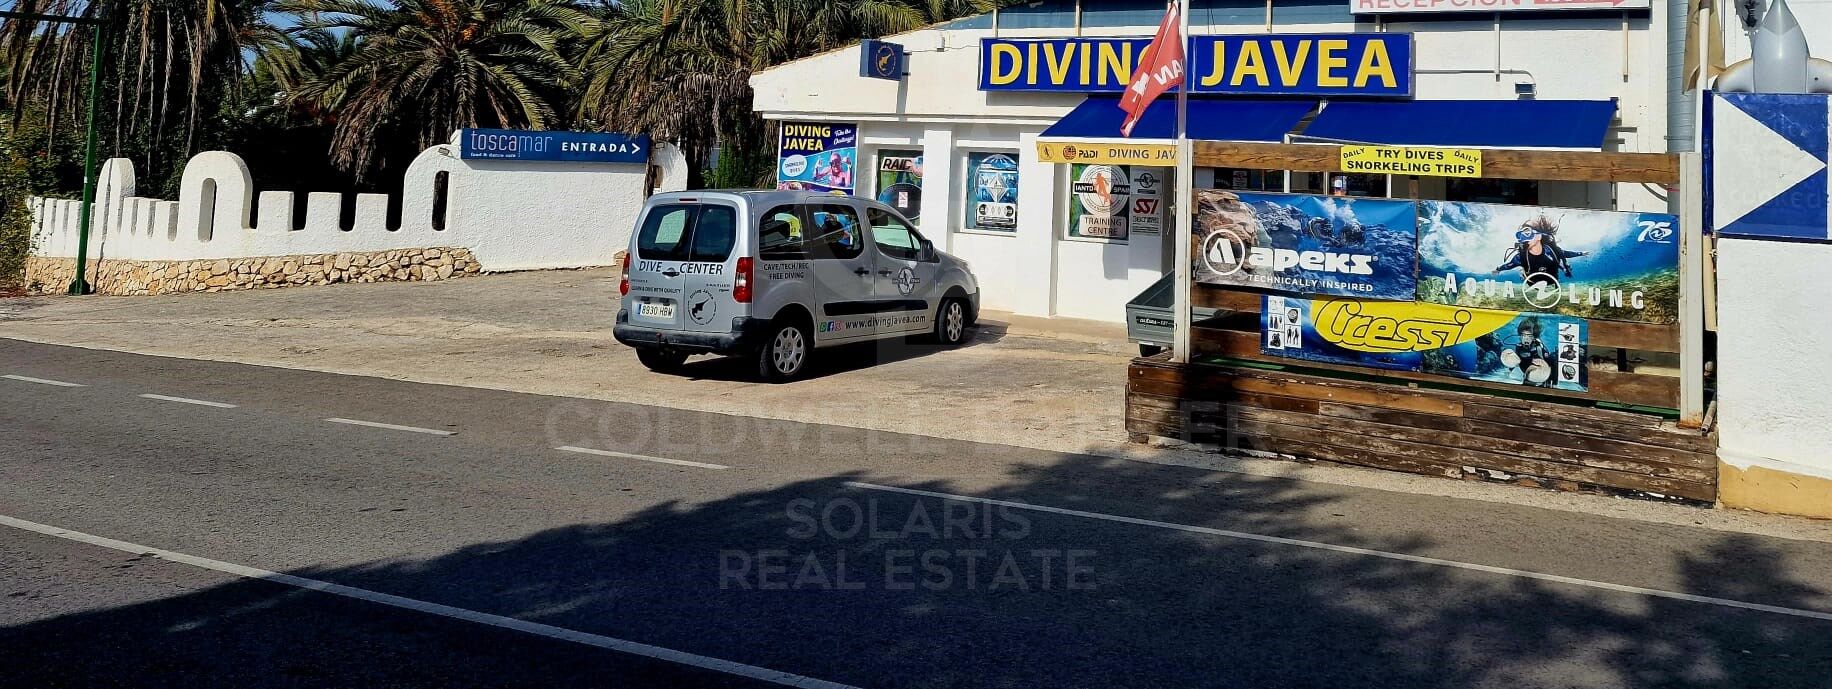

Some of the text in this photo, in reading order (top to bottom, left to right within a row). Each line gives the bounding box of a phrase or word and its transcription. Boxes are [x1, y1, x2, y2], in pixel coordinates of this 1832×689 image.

[989, 39, 1398, 89] DIVIN JAVEA
[784, 124, 831, 138] DIVING
[470, 130, 553, 153] toscamar
[561, 141, 628, 153] ENTRADA
[783, 138, 824, 151] JAVEA
[1078, 150, 1098, 159] PADI
[1108, 148, 1176, 160] DIVING JAV
[1343, 147, 1366, 159] DAILY
[1375, 149, 1444, 160] TRY DIVES
[1454, 150, 1479, 163] DAILY
[1347, 160, 1475, 174] SNORKELING TRIPS
[1133, 198, 1159, 215] SSI
[1084, 217, 1122, 226] TRAINING
[1087, 226, 1118, 235] CENTRE
[1248, 246, 1373, 275] apeks
[639, 260, 724, 275] DIVE CENTER
[769, 271, 804, 280] FREE DIVING
[1248, 274, 1373, 292] TECHNICALLY INSPIRED
[1444, 272, 1644, 310] AQUA LUNG
[641, 305, 673, 317] 8930 HBW
[845, 314, 926, 329] www.divingjavea.com
[1314, 299, 1472, 351] Cressi
